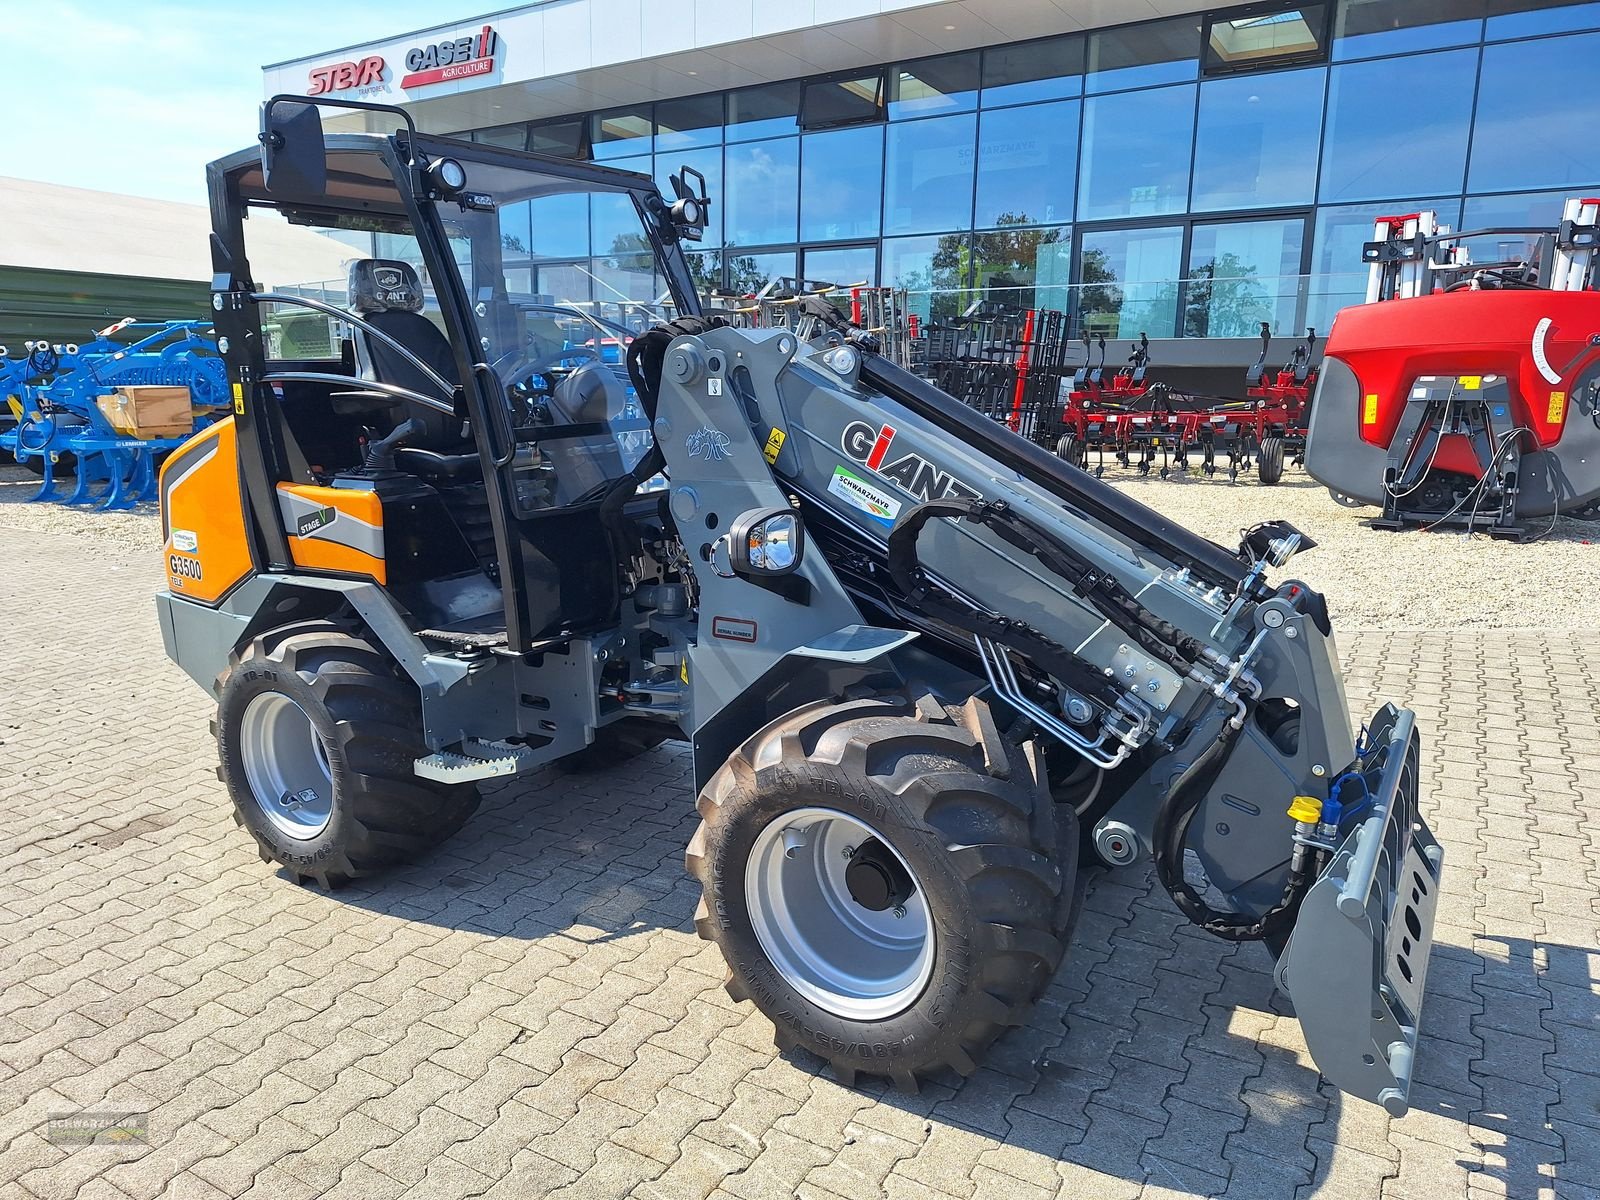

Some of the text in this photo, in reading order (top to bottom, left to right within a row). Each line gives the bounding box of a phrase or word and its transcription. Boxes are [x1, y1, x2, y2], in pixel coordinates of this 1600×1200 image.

[405, 37, 472, 72] CASE
[307, 56, 386, 96] STEYR
[441, 61, 489, 79] AGRICULTURE
[377, 291, 406, 301] GANT
[838, 475, 890, 510] SCHWARZMAYR
[300, 508, 328, 535] STAGE V
[170, 554, 202, 581] G3500
[170, 576, 183, 588] TELE
[811, 776, 886, 819] TR-01
